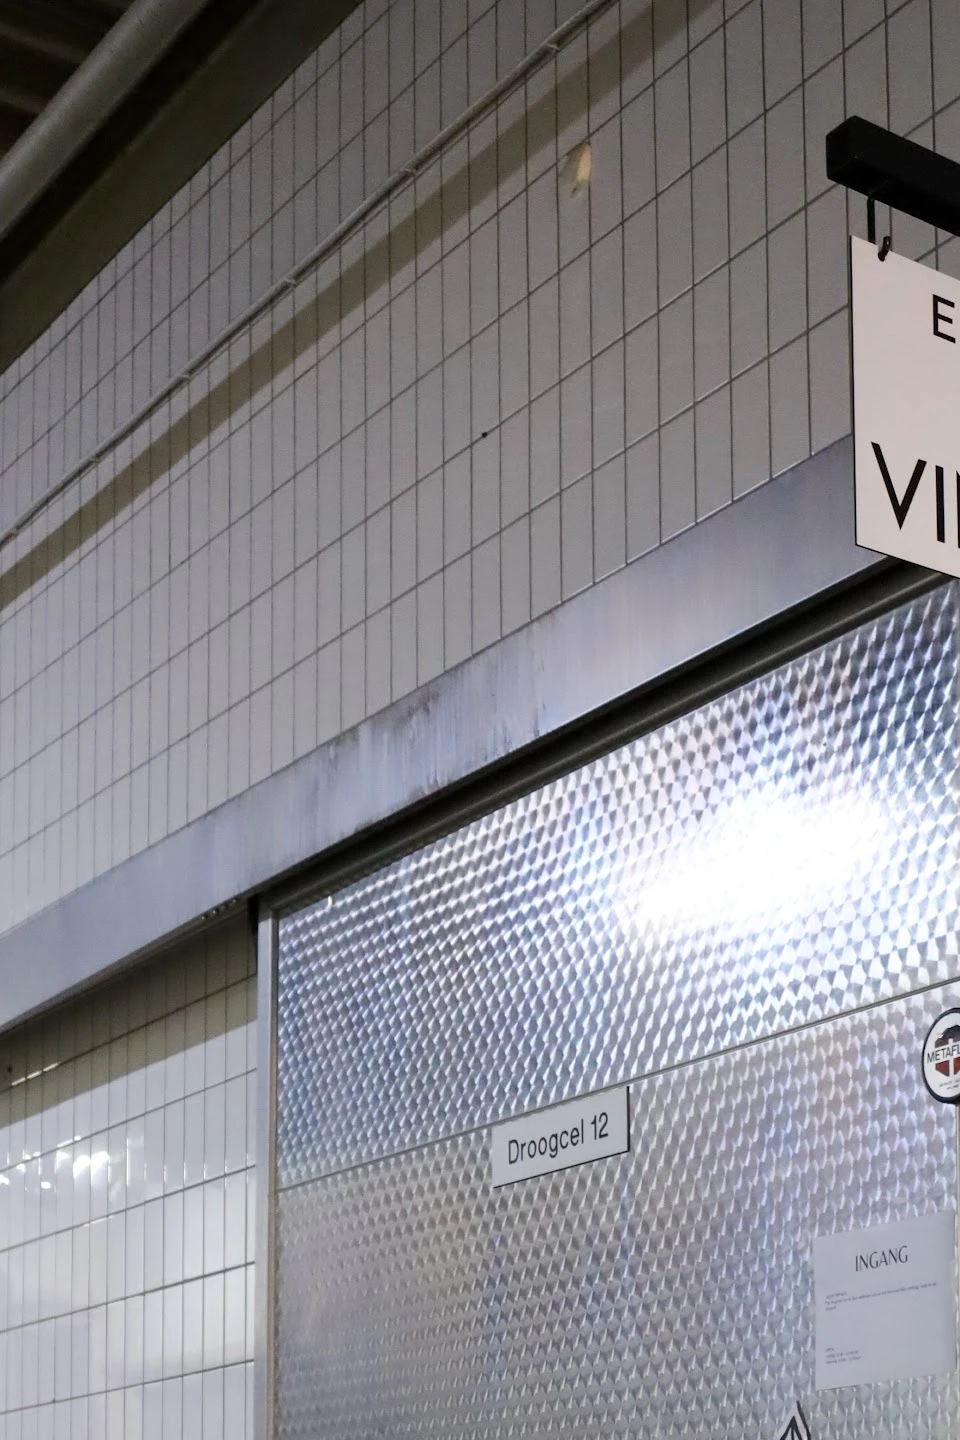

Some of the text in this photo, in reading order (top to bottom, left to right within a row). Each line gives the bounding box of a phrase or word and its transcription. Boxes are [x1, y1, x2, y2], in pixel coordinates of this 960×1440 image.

[508, 1112, 609, 1165] Droogcel 12
[855, 1245, 909, 1272] INGANG
